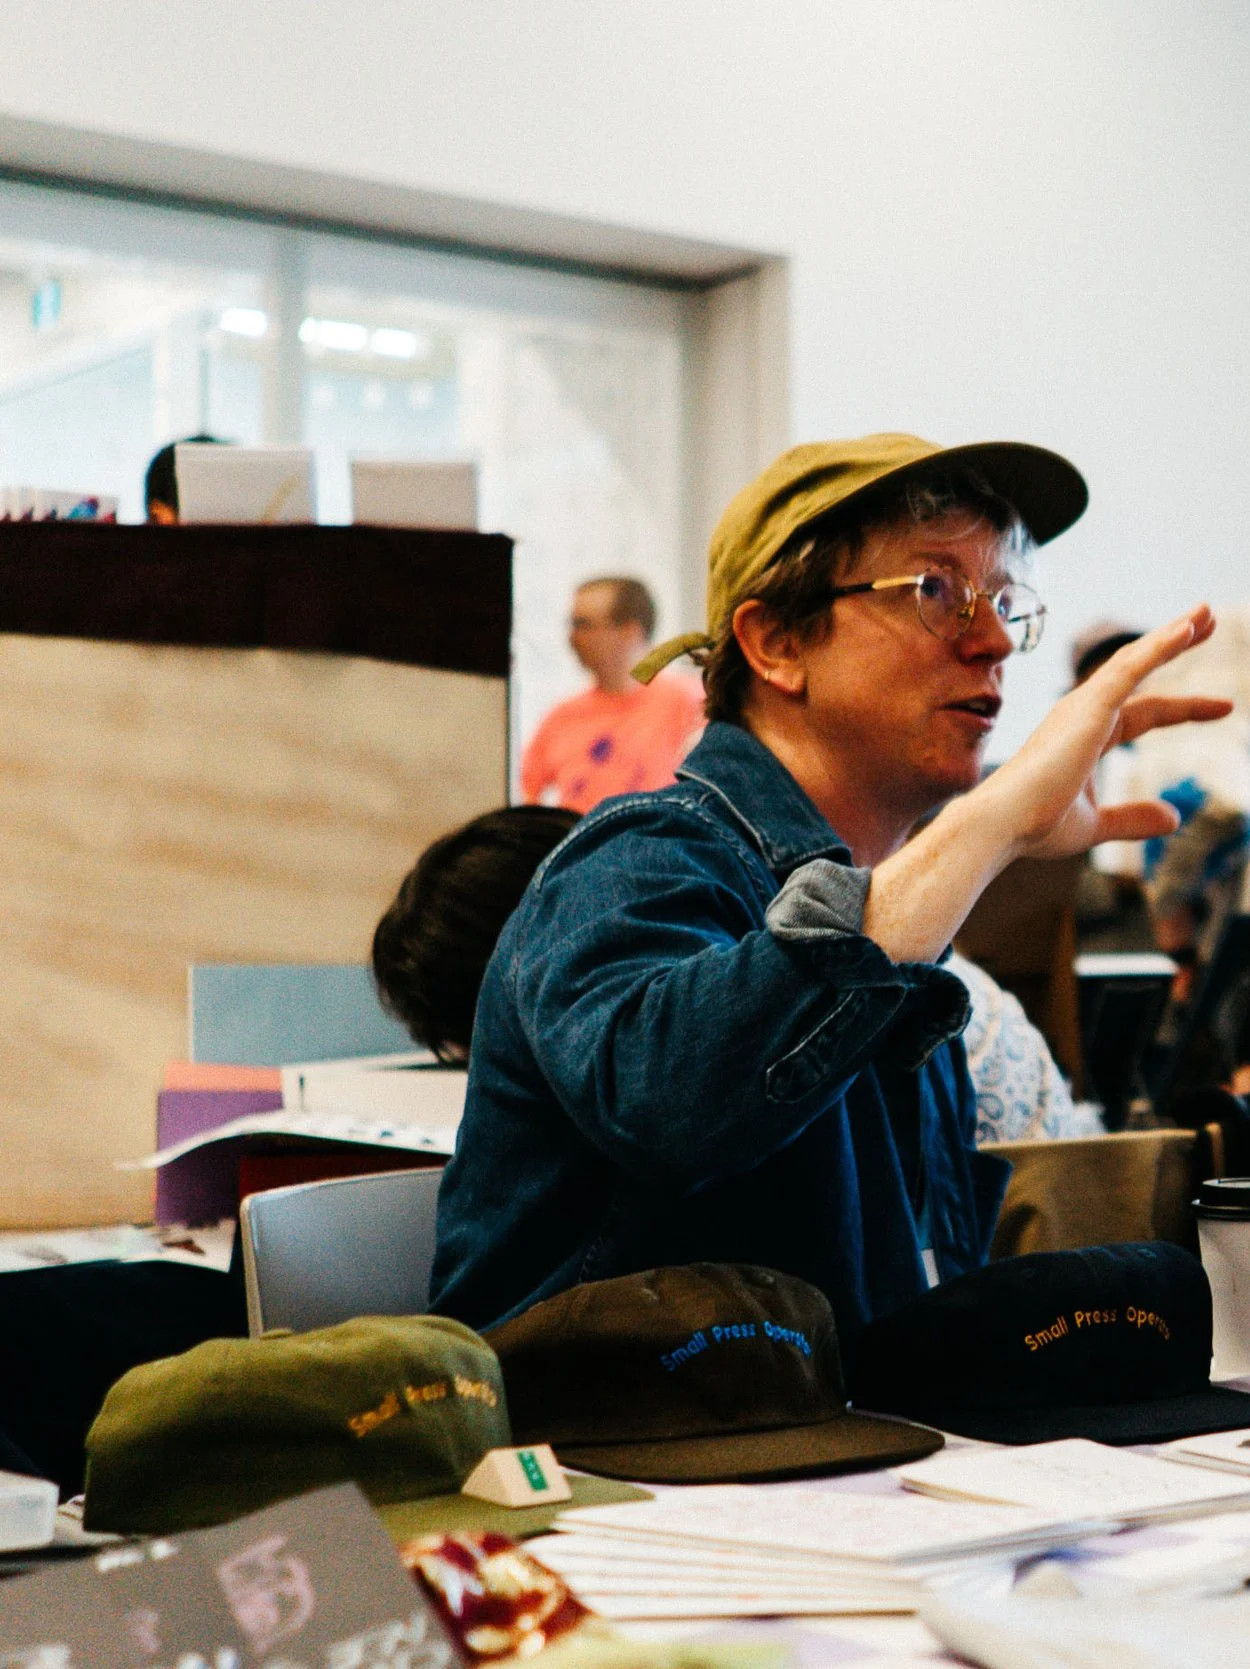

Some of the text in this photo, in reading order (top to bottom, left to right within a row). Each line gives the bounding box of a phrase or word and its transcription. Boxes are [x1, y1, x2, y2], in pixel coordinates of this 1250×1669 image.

[660, 1330, 709, 1372] Small
[711, 1322, 757, 1344] Press
[1024, 1316, 1069, 1351] Small
[1074, 1308, 1118, 1328] Press
[347, 1390, 401, 1438] Small
[405, 1380, 448, 1408] Press
